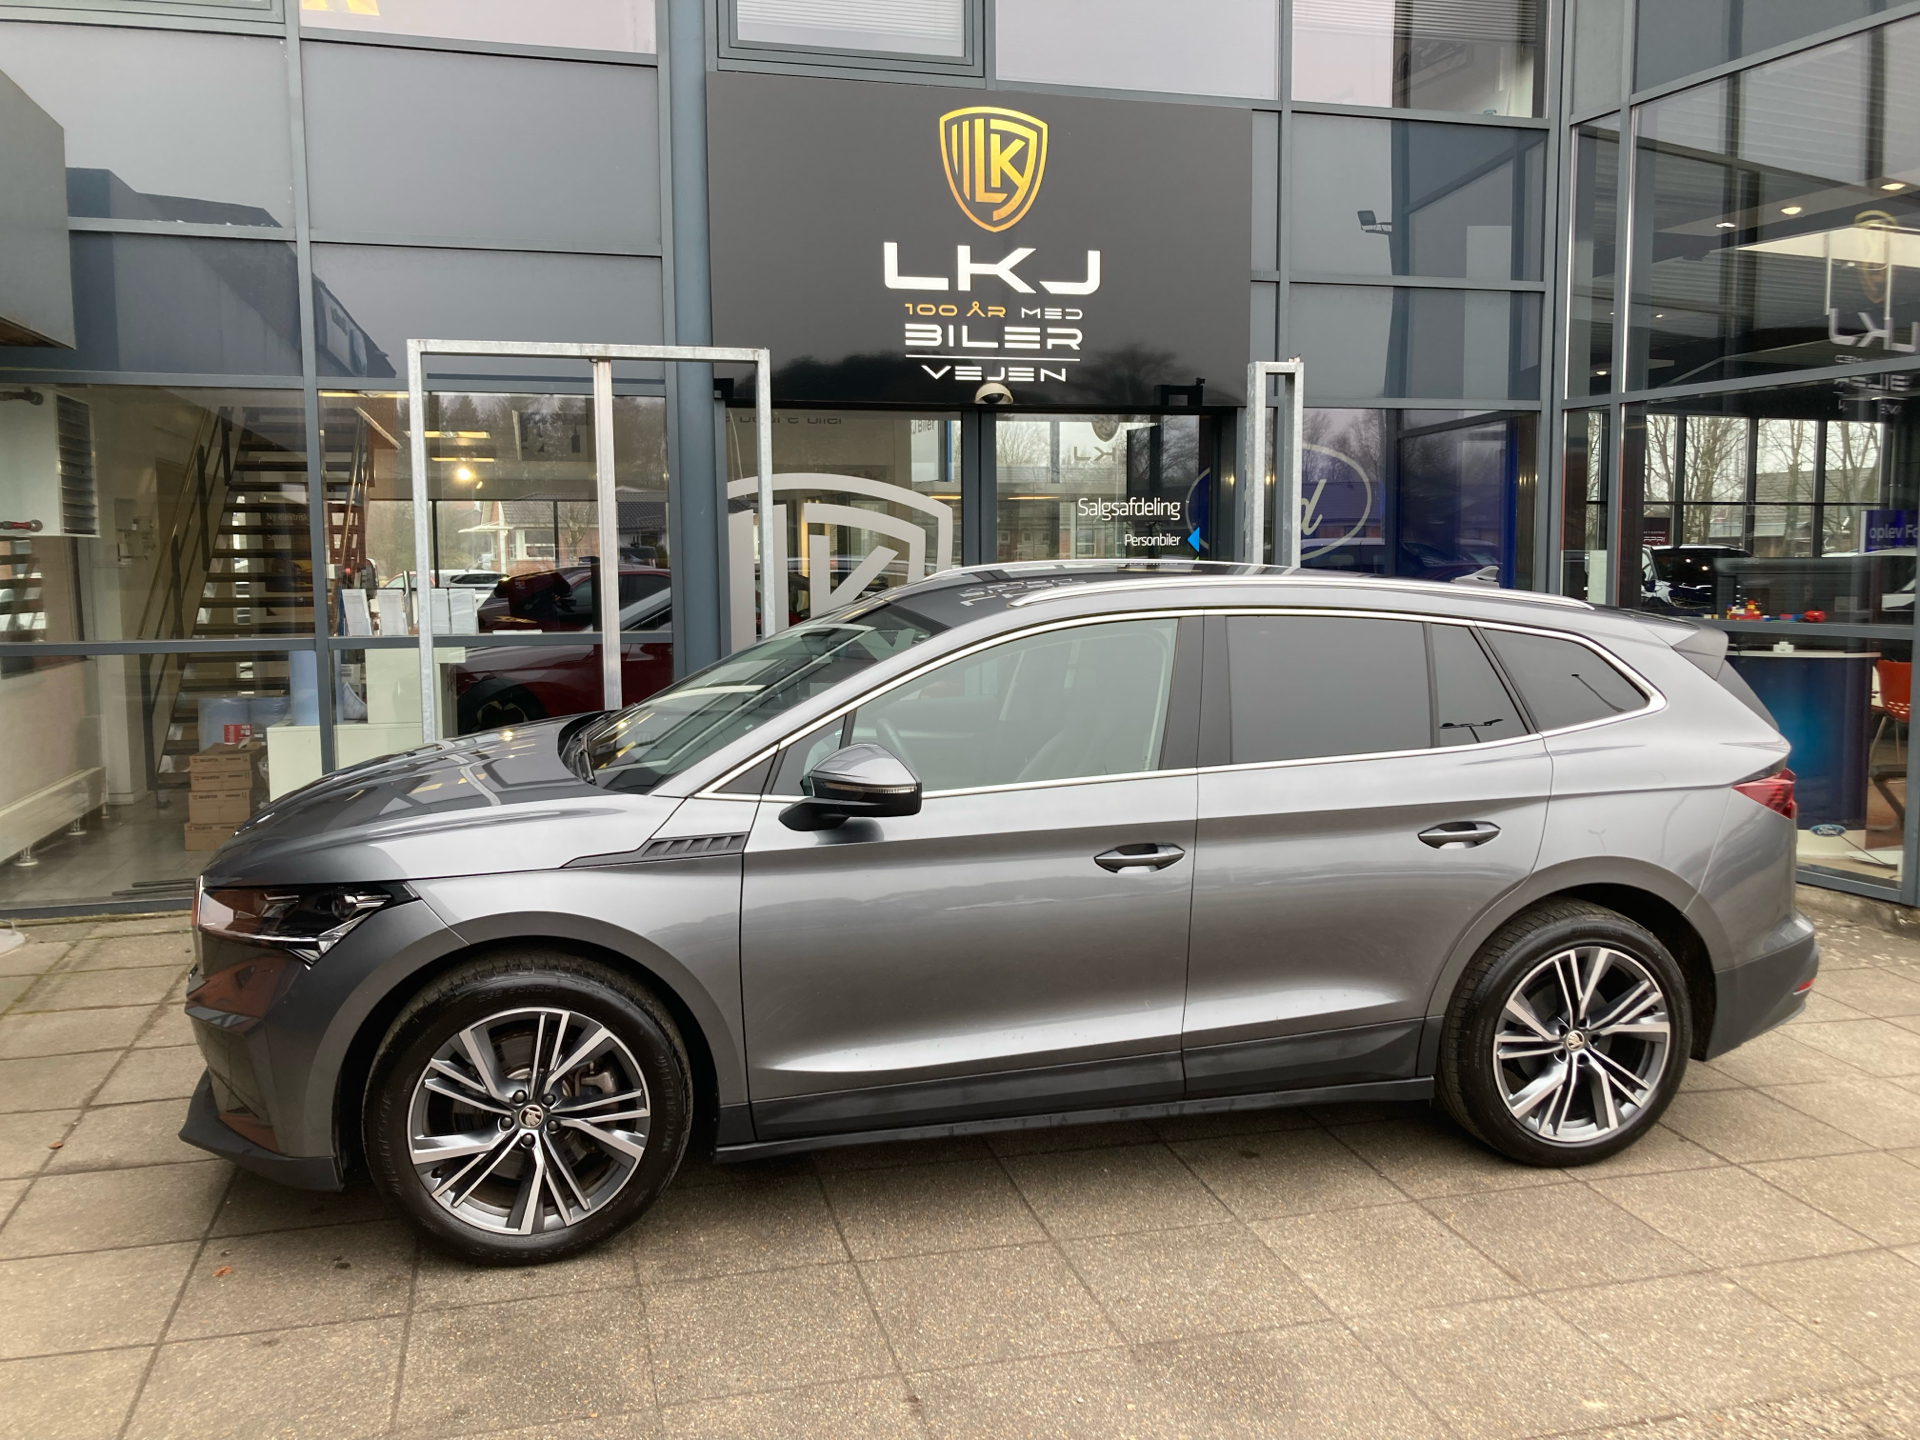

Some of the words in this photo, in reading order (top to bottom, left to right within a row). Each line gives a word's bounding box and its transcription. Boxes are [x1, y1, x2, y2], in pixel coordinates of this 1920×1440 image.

[884, 242, 1101, 295] LKJ
[905, 303, 958, 317] 100
[966, 301, 1006, 318] ÅR
[1021, 307, 1083, 320] MED
[905, 323, 1083, 350] BILER
[921, 365, 1067, 382] VEJEN
[1078, 497, 1181, 521] Salgsafdeling
[1124, 533, 1181, 547] Personbiler
[1869, 523, 1903, 542] oplev
